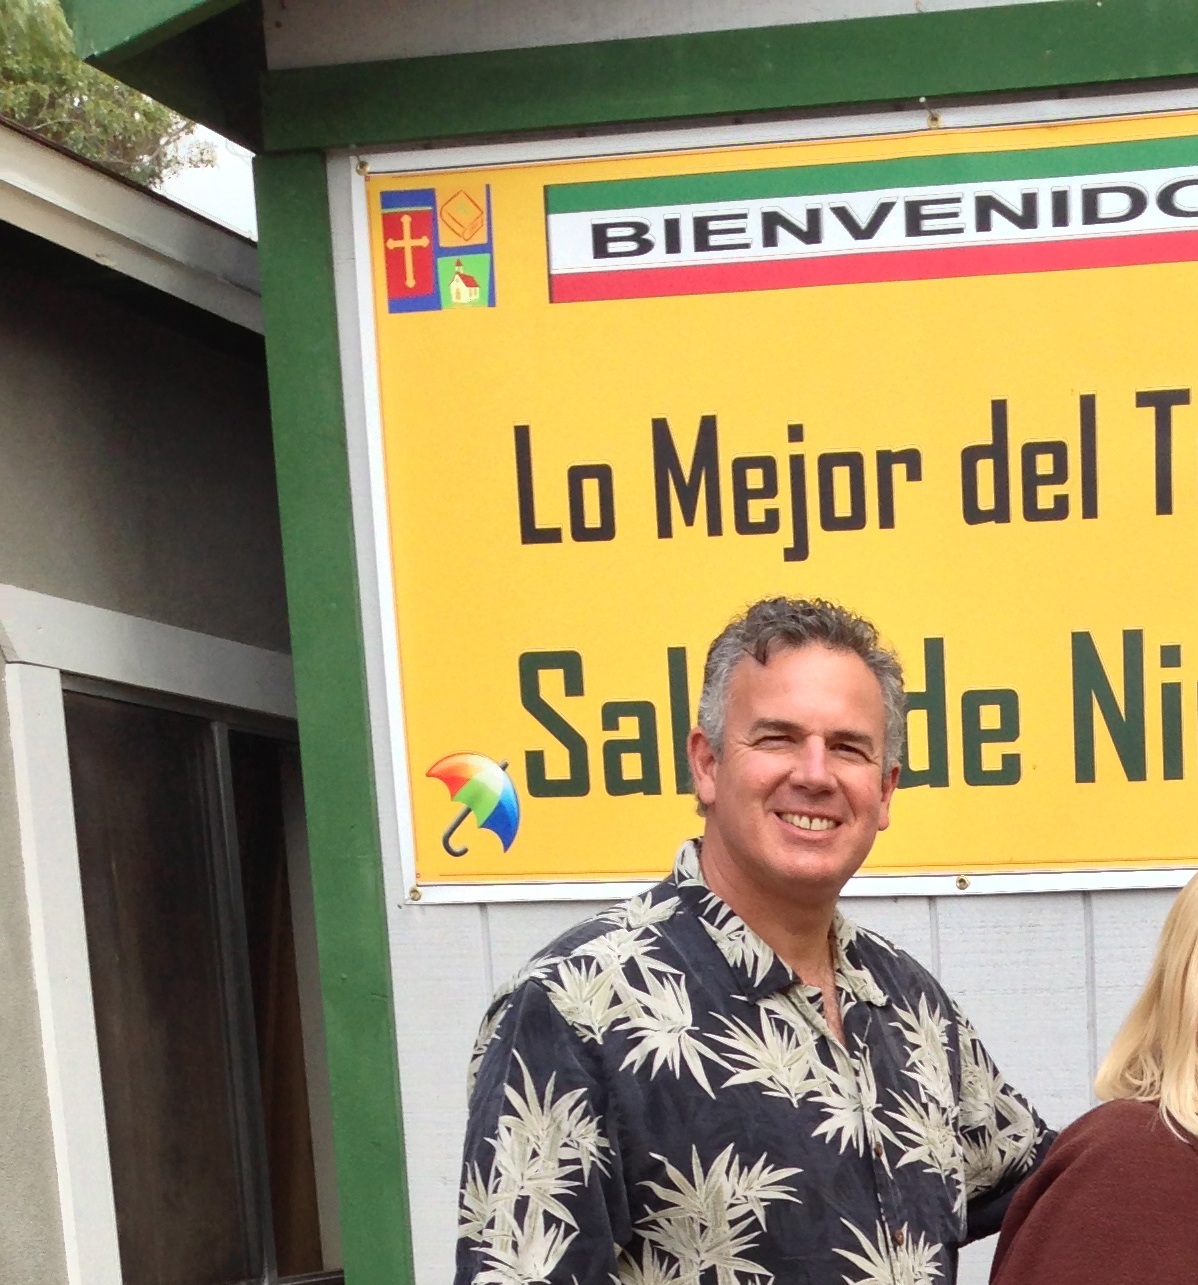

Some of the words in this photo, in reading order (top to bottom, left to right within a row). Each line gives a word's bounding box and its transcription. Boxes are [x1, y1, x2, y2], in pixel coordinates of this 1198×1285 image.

[513, 425, 617, 545] Lo
[651, 414, 923, 563] Mejor
[961, 394, 1098, 526] del
[518, 645, 692, 798] Sal
[899, 637, 1022, 790] de
